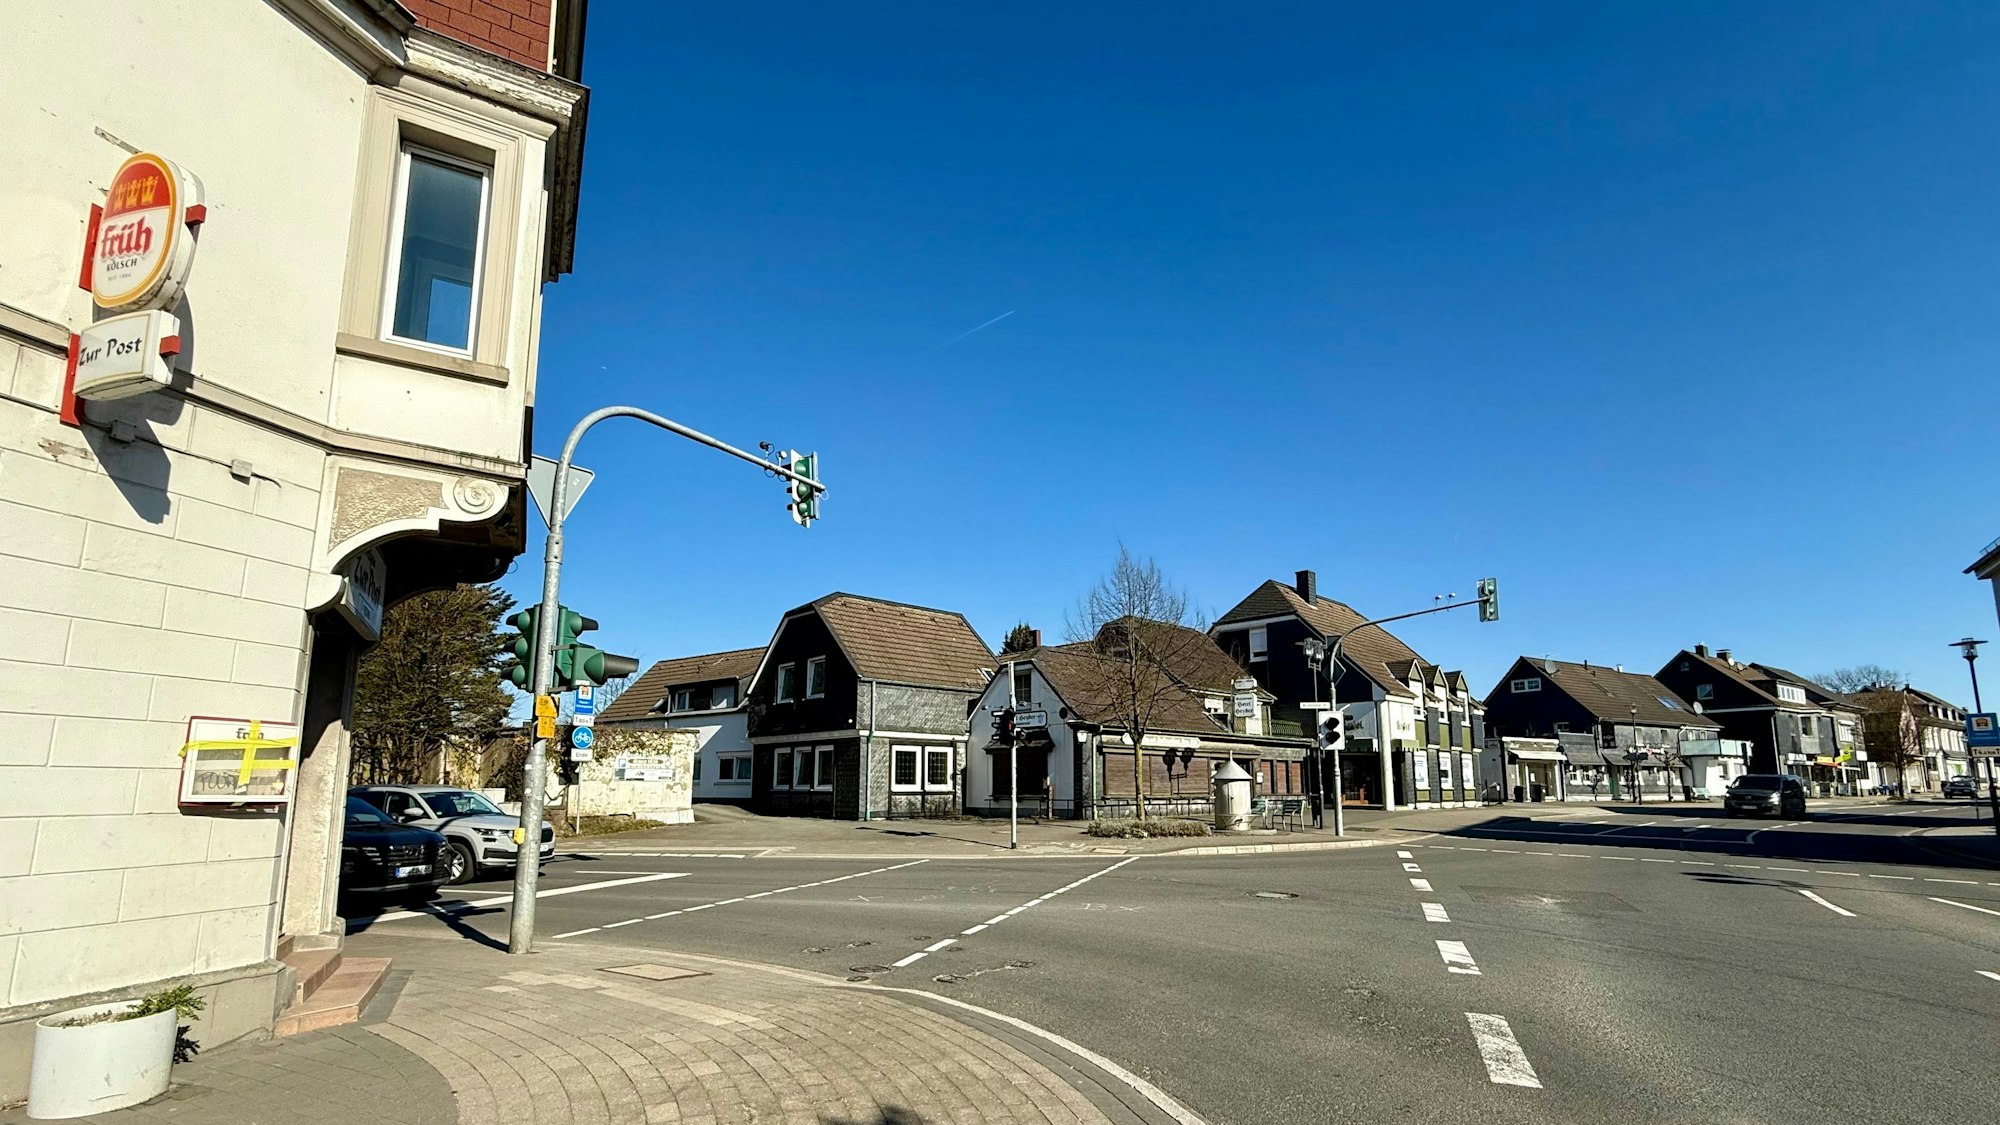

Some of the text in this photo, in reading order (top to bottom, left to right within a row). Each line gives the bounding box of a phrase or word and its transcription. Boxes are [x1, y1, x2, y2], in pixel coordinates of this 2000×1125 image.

[100, 216, 152, 259] früh
[106, 258, 137, 272] KÖLSCH
[79, 337, 142, 366] Zur Post
